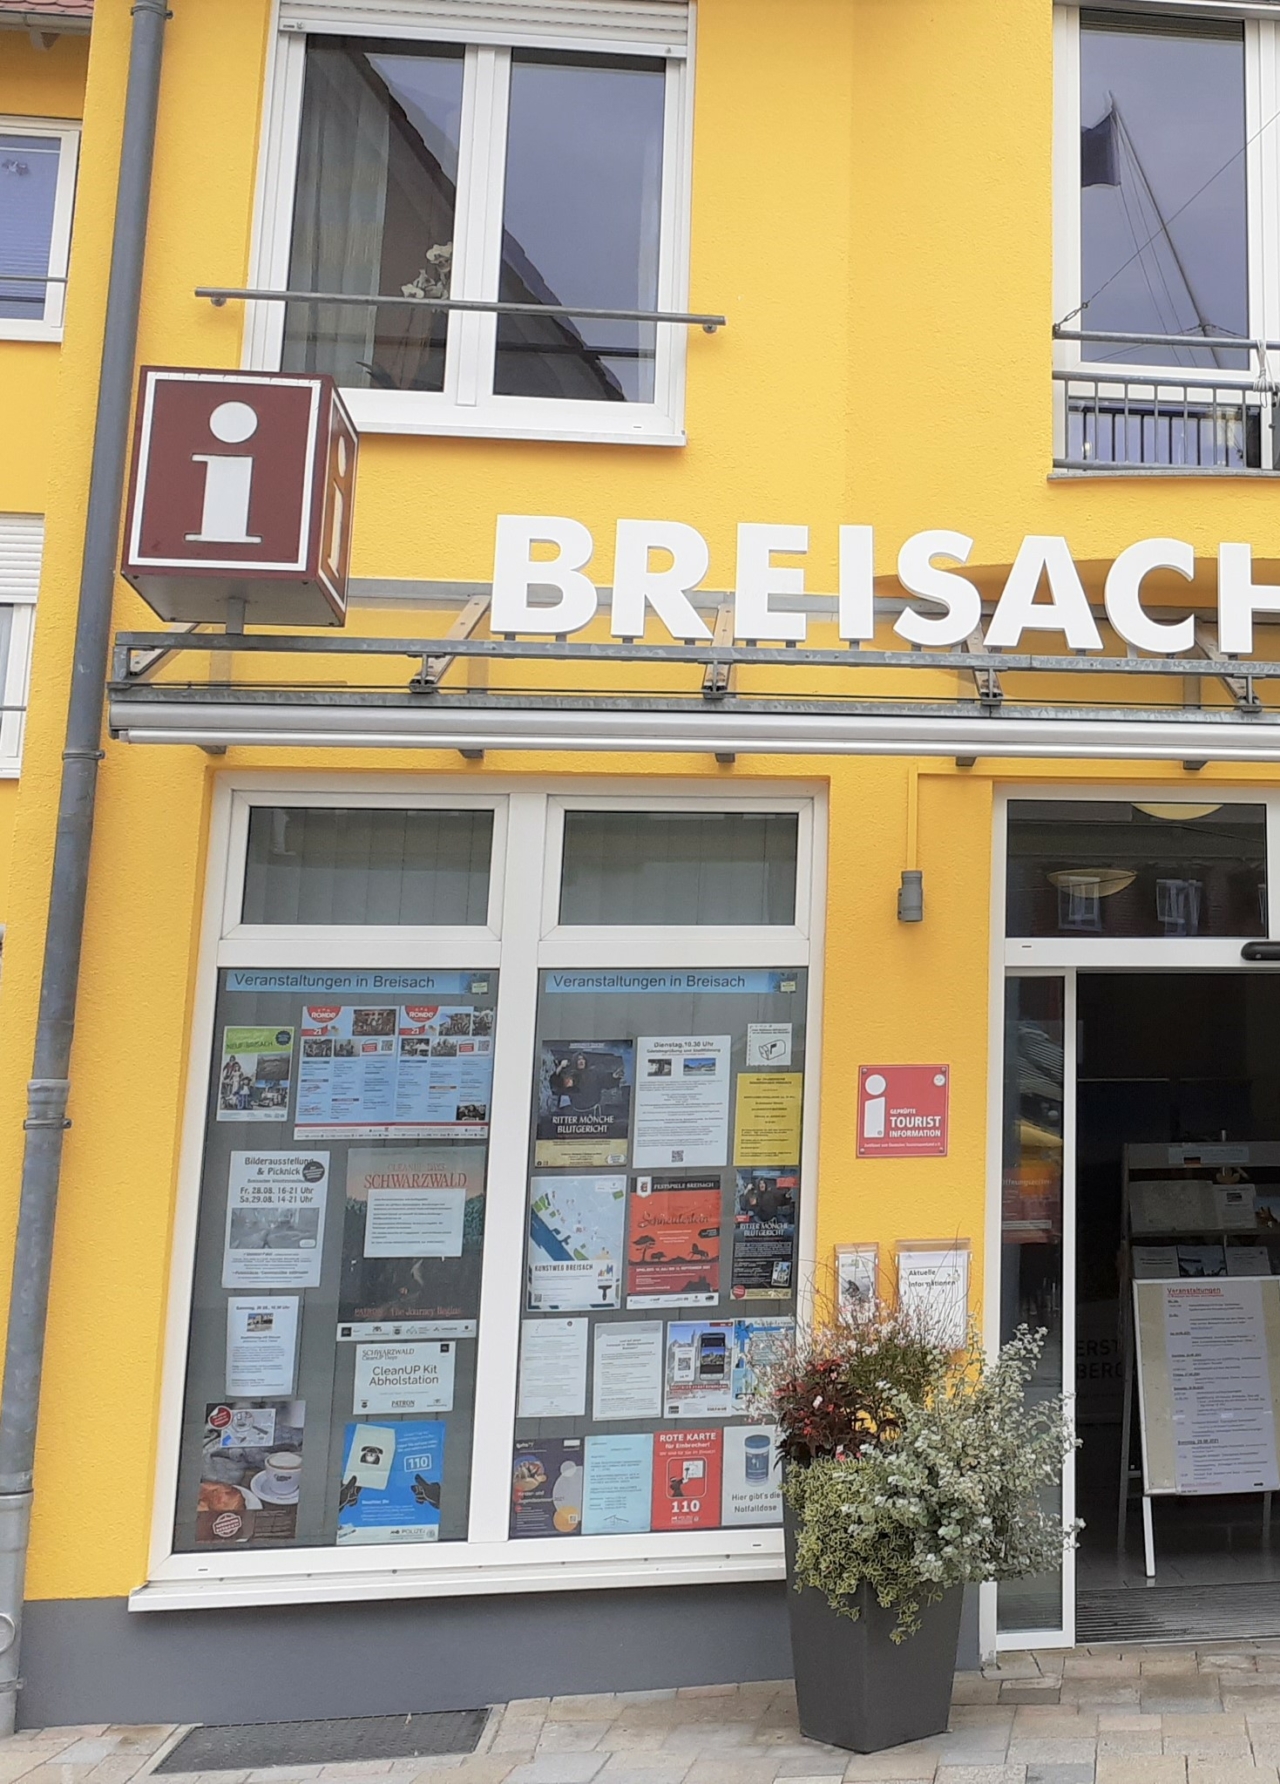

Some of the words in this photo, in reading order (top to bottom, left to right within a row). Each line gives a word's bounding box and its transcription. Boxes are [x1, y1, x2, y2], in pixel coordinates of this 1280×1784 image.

[234, 973, 351, 990] Veranstaltungen
[356, 975, 368, 987] in
[373, 975, 435, 988] Breisach
[553, 974, 666, 990] Veranstaltungen
[670, 974, 682, 987] in
[687, 973, 745, 988] Breisach
[552, 1115, 577, 1124] RITTER
[580, 1113, 614, 1124] MÖNCHE
[890, 1116, 941, 1128] TOURIST
[557, 1125, 608, 1134] BLUTGERICHT
[889, 1129, 941, 1138] INFORMATION
[257, 1168, 264, 1176] &
[267, 1167, 301, 1176] Picknick
[364, 1172, 467, 1189] SCHWARZWALD
[301, 1187, 314, 1195] Uhr
[534, 1264, 564, 1272] KUNSTWEG
[566, 1263, 593, 1271] BREISACH
[372, 1365, 421, 1376] CleanUP
[423, 1364, 438, 1374] Kit
[369, 1375, 439, 1386] Abholstation
[660, 1434, 684, 1442] ROTE
[687, 1432, 716, 1441] KARTE
[408, 1457, 428, 1469] 110
[732, 1493, 747, 1501] Hier
[769, 1491, 781, 1499] die
[672, 1500, 700, 1512] 110
[734, 1503, 777, 1513] Notfalldose
